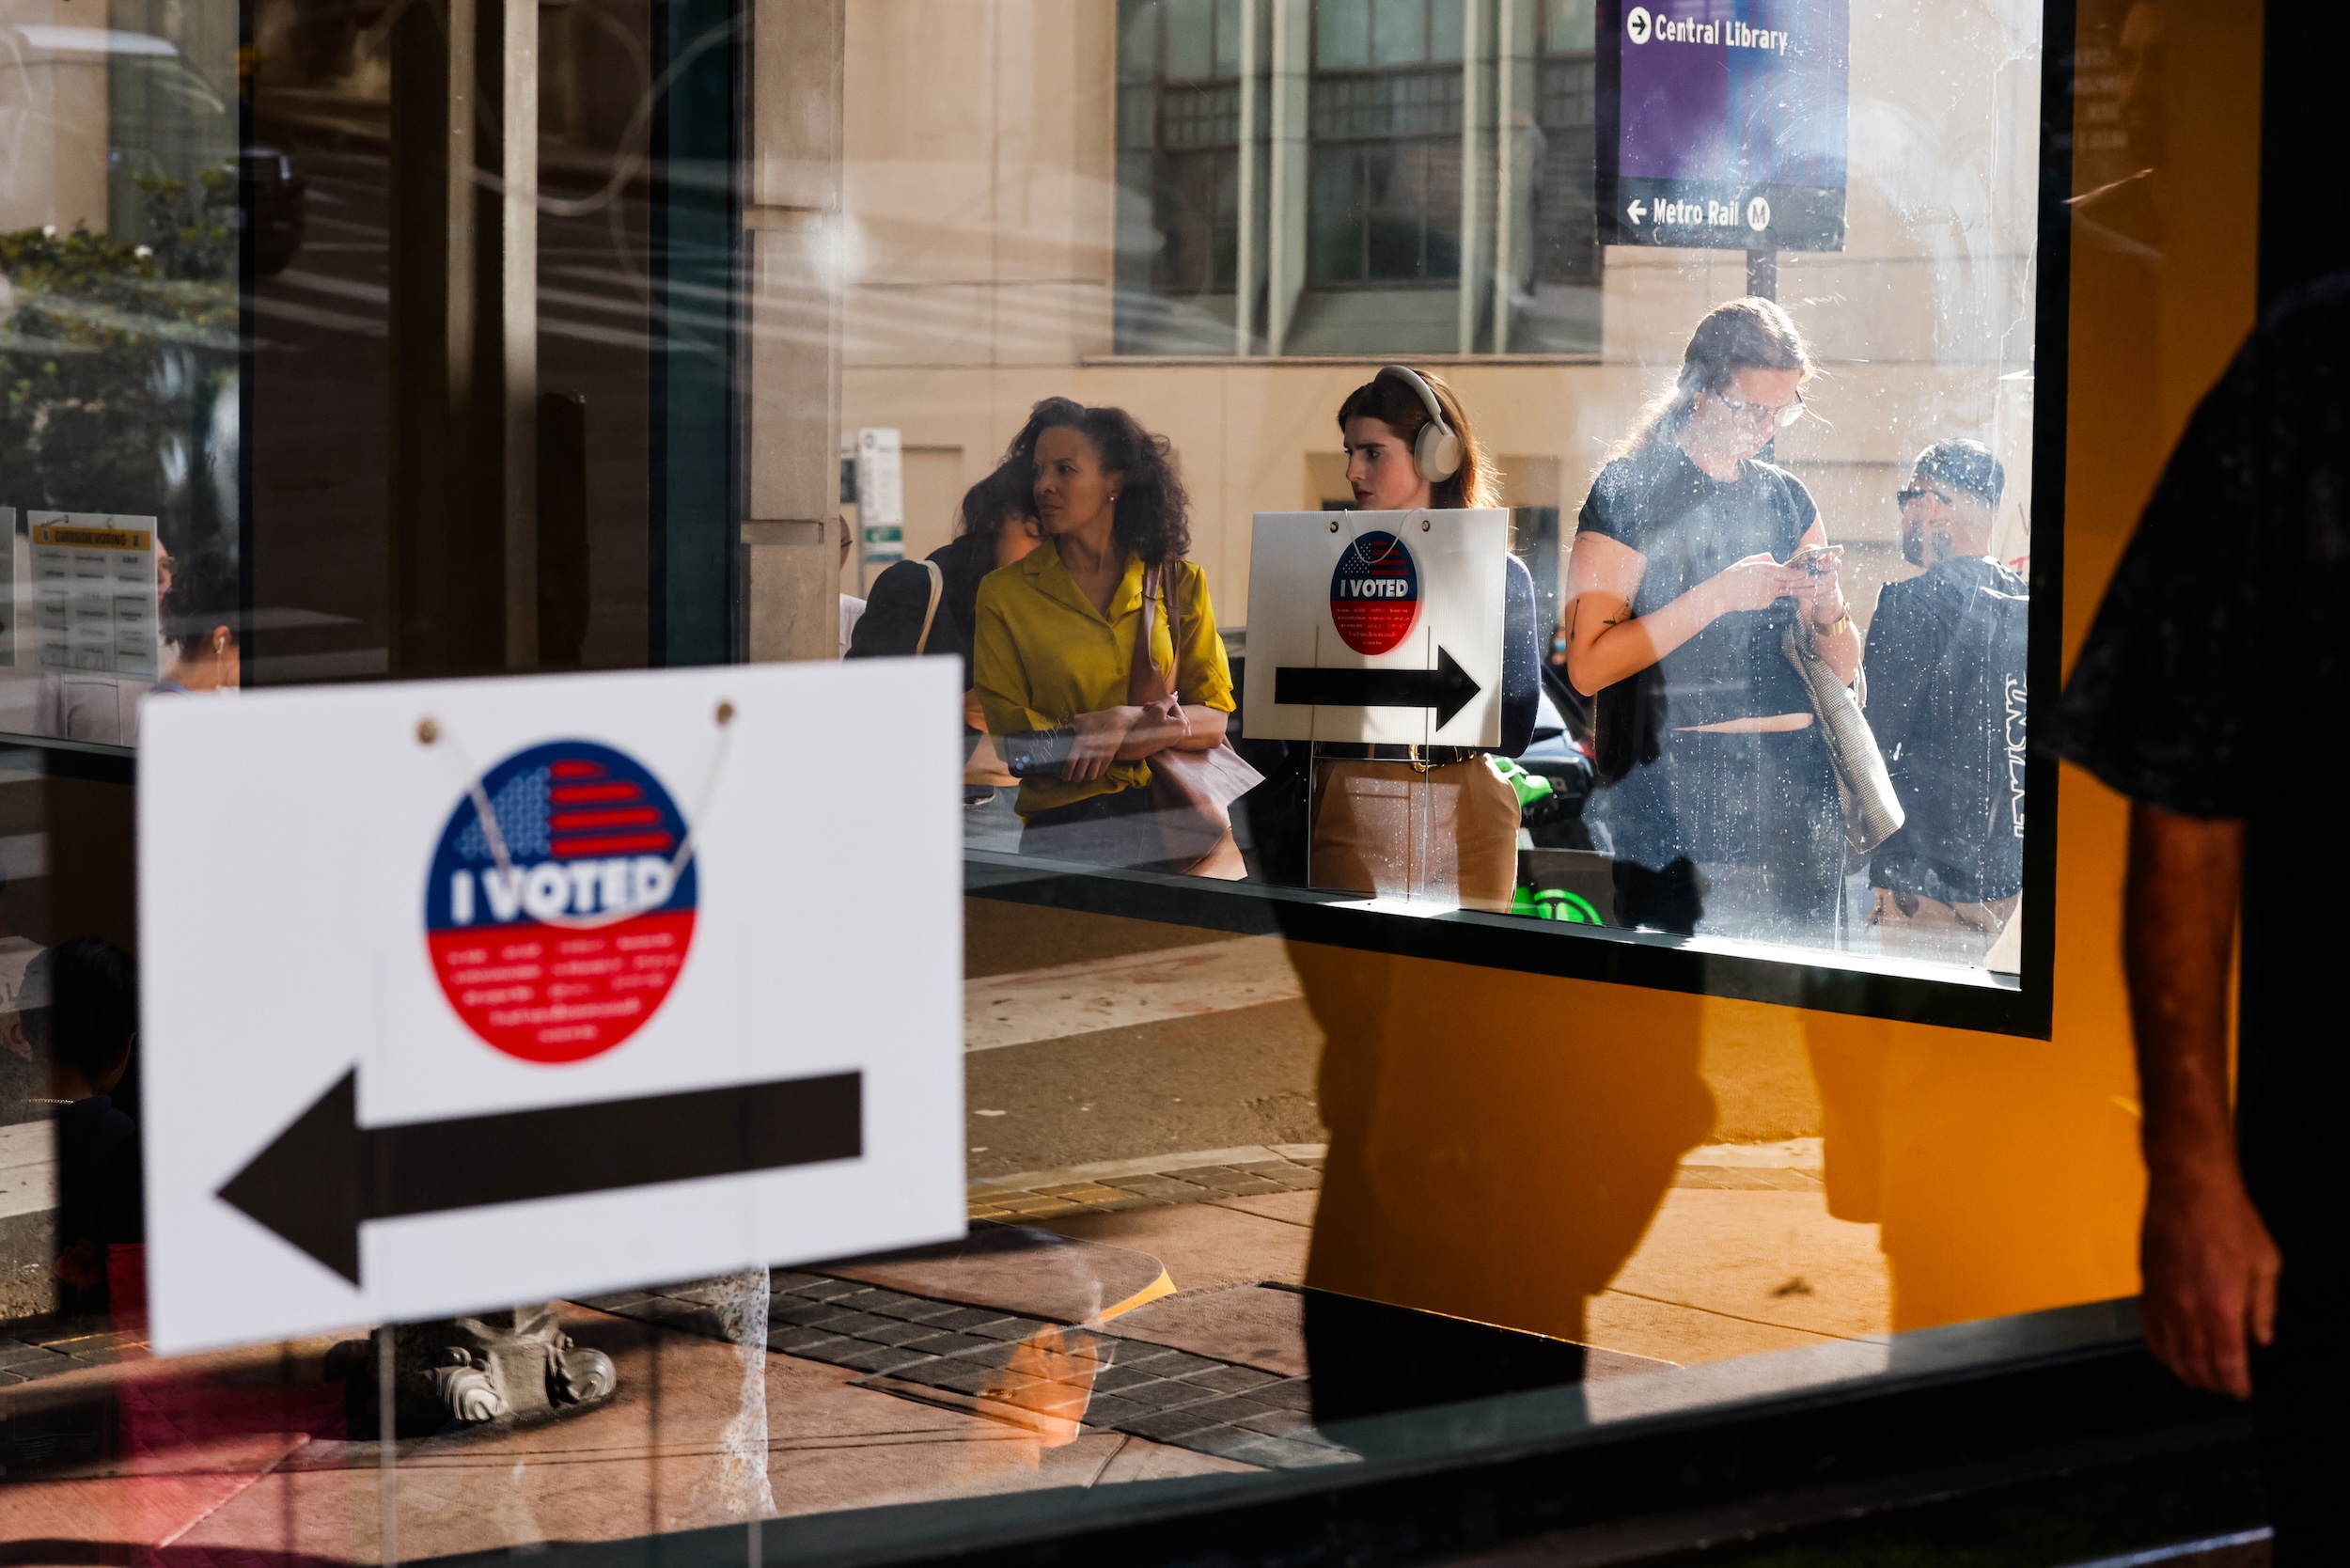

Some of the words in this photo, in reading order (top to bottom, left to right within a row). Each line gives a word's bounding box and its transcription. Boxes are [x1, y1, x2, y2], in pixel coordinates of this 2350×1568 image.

[1655, 13, 1719, 45] Central
[1725, 20, 1788, 56] Library
[1653, 196, 1703, 225] Metro
[1708, 199, 1739, 227] Rail
[93, 533, 127, 545] VOTING
[1340, 578, 1346, 598] I
[1350, 578, 1409, 598] VOTED
[451, 868, 476, 924] I
[480, 855, 677, 920] VOTED
